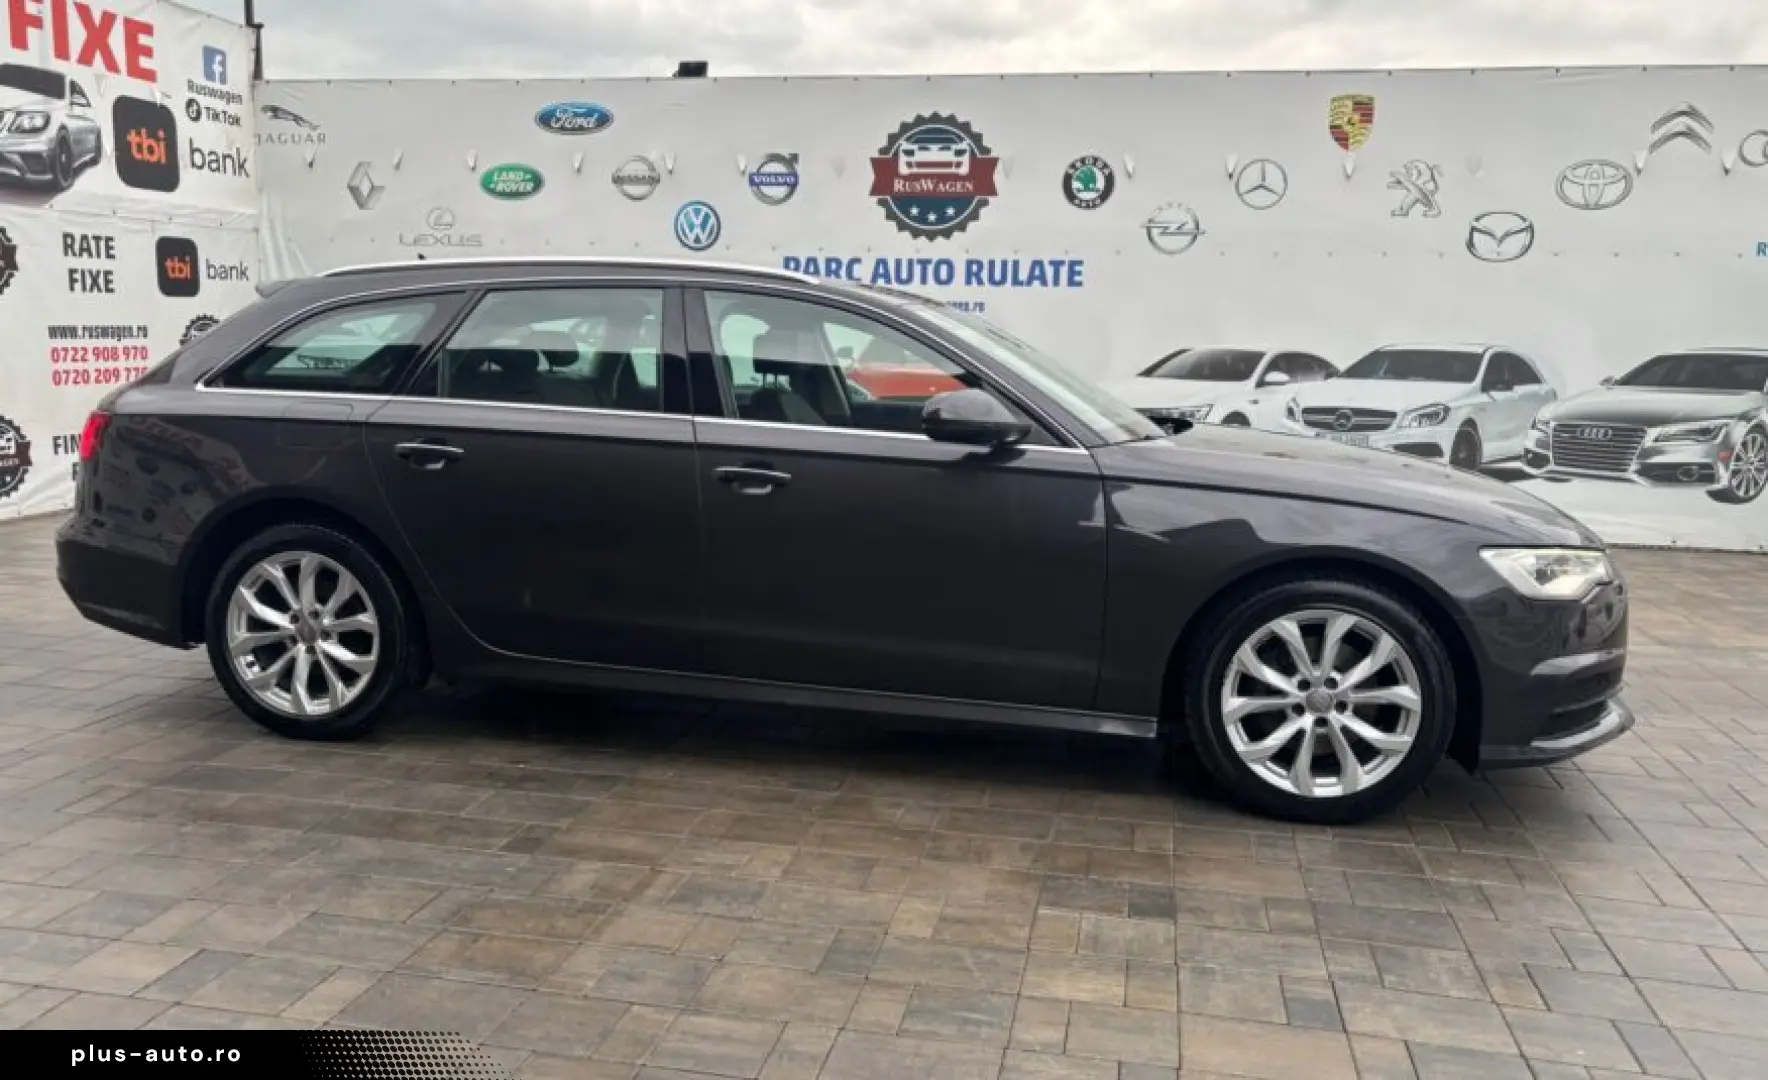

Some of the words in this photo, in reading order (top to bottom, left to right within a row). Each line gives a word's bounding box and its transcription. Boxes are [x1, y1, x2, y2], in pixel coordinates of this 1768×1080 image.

[8, 0, 158, 83] FIXE
[550, 107, 600, 129] Ford
[254, 132, 326, 146] JAGUAR
[127, 128, 167, 164] tbi
[188, 137, 250, 178] bank
[752, 174, 796, 185] VOLVO
[62, 231, 117, 260] RATE
[399, 233, 484, 247] LEXUS
[164, 256, 192, 280] tbi
[206, 258, 249, 281] bank
[870, 257, 956, 286] AUTO
[964, 258, 1085, 288] RULATE
[67, 267, 116, 294] FIXE
[47, 324, 149, 342] www.ruswagen.ro
[51, 346, 90, 363] 0722
[92, 345, 120, 362] 908
[122, 345, 149, 361] 970
[52, 368, 91, 387] 0720
[94, 366, 120, 385] 209
